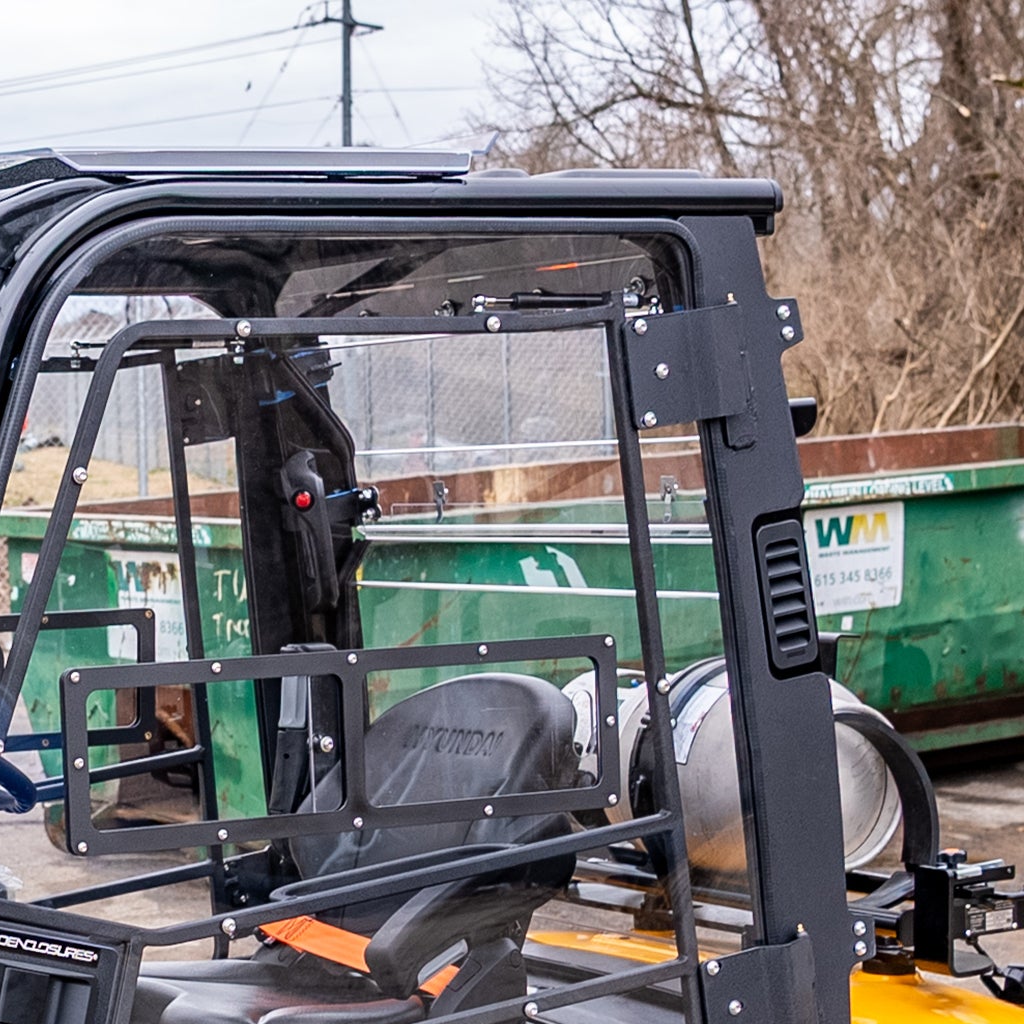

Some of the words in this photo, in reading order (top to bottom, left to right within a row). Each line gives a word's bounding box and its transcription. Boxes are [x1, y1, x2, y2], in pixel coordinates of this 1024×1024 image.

[815, 512, 890, 548] WM
[839, 569, 861, 584] 345
[864, 566, 893, 582] 8366
